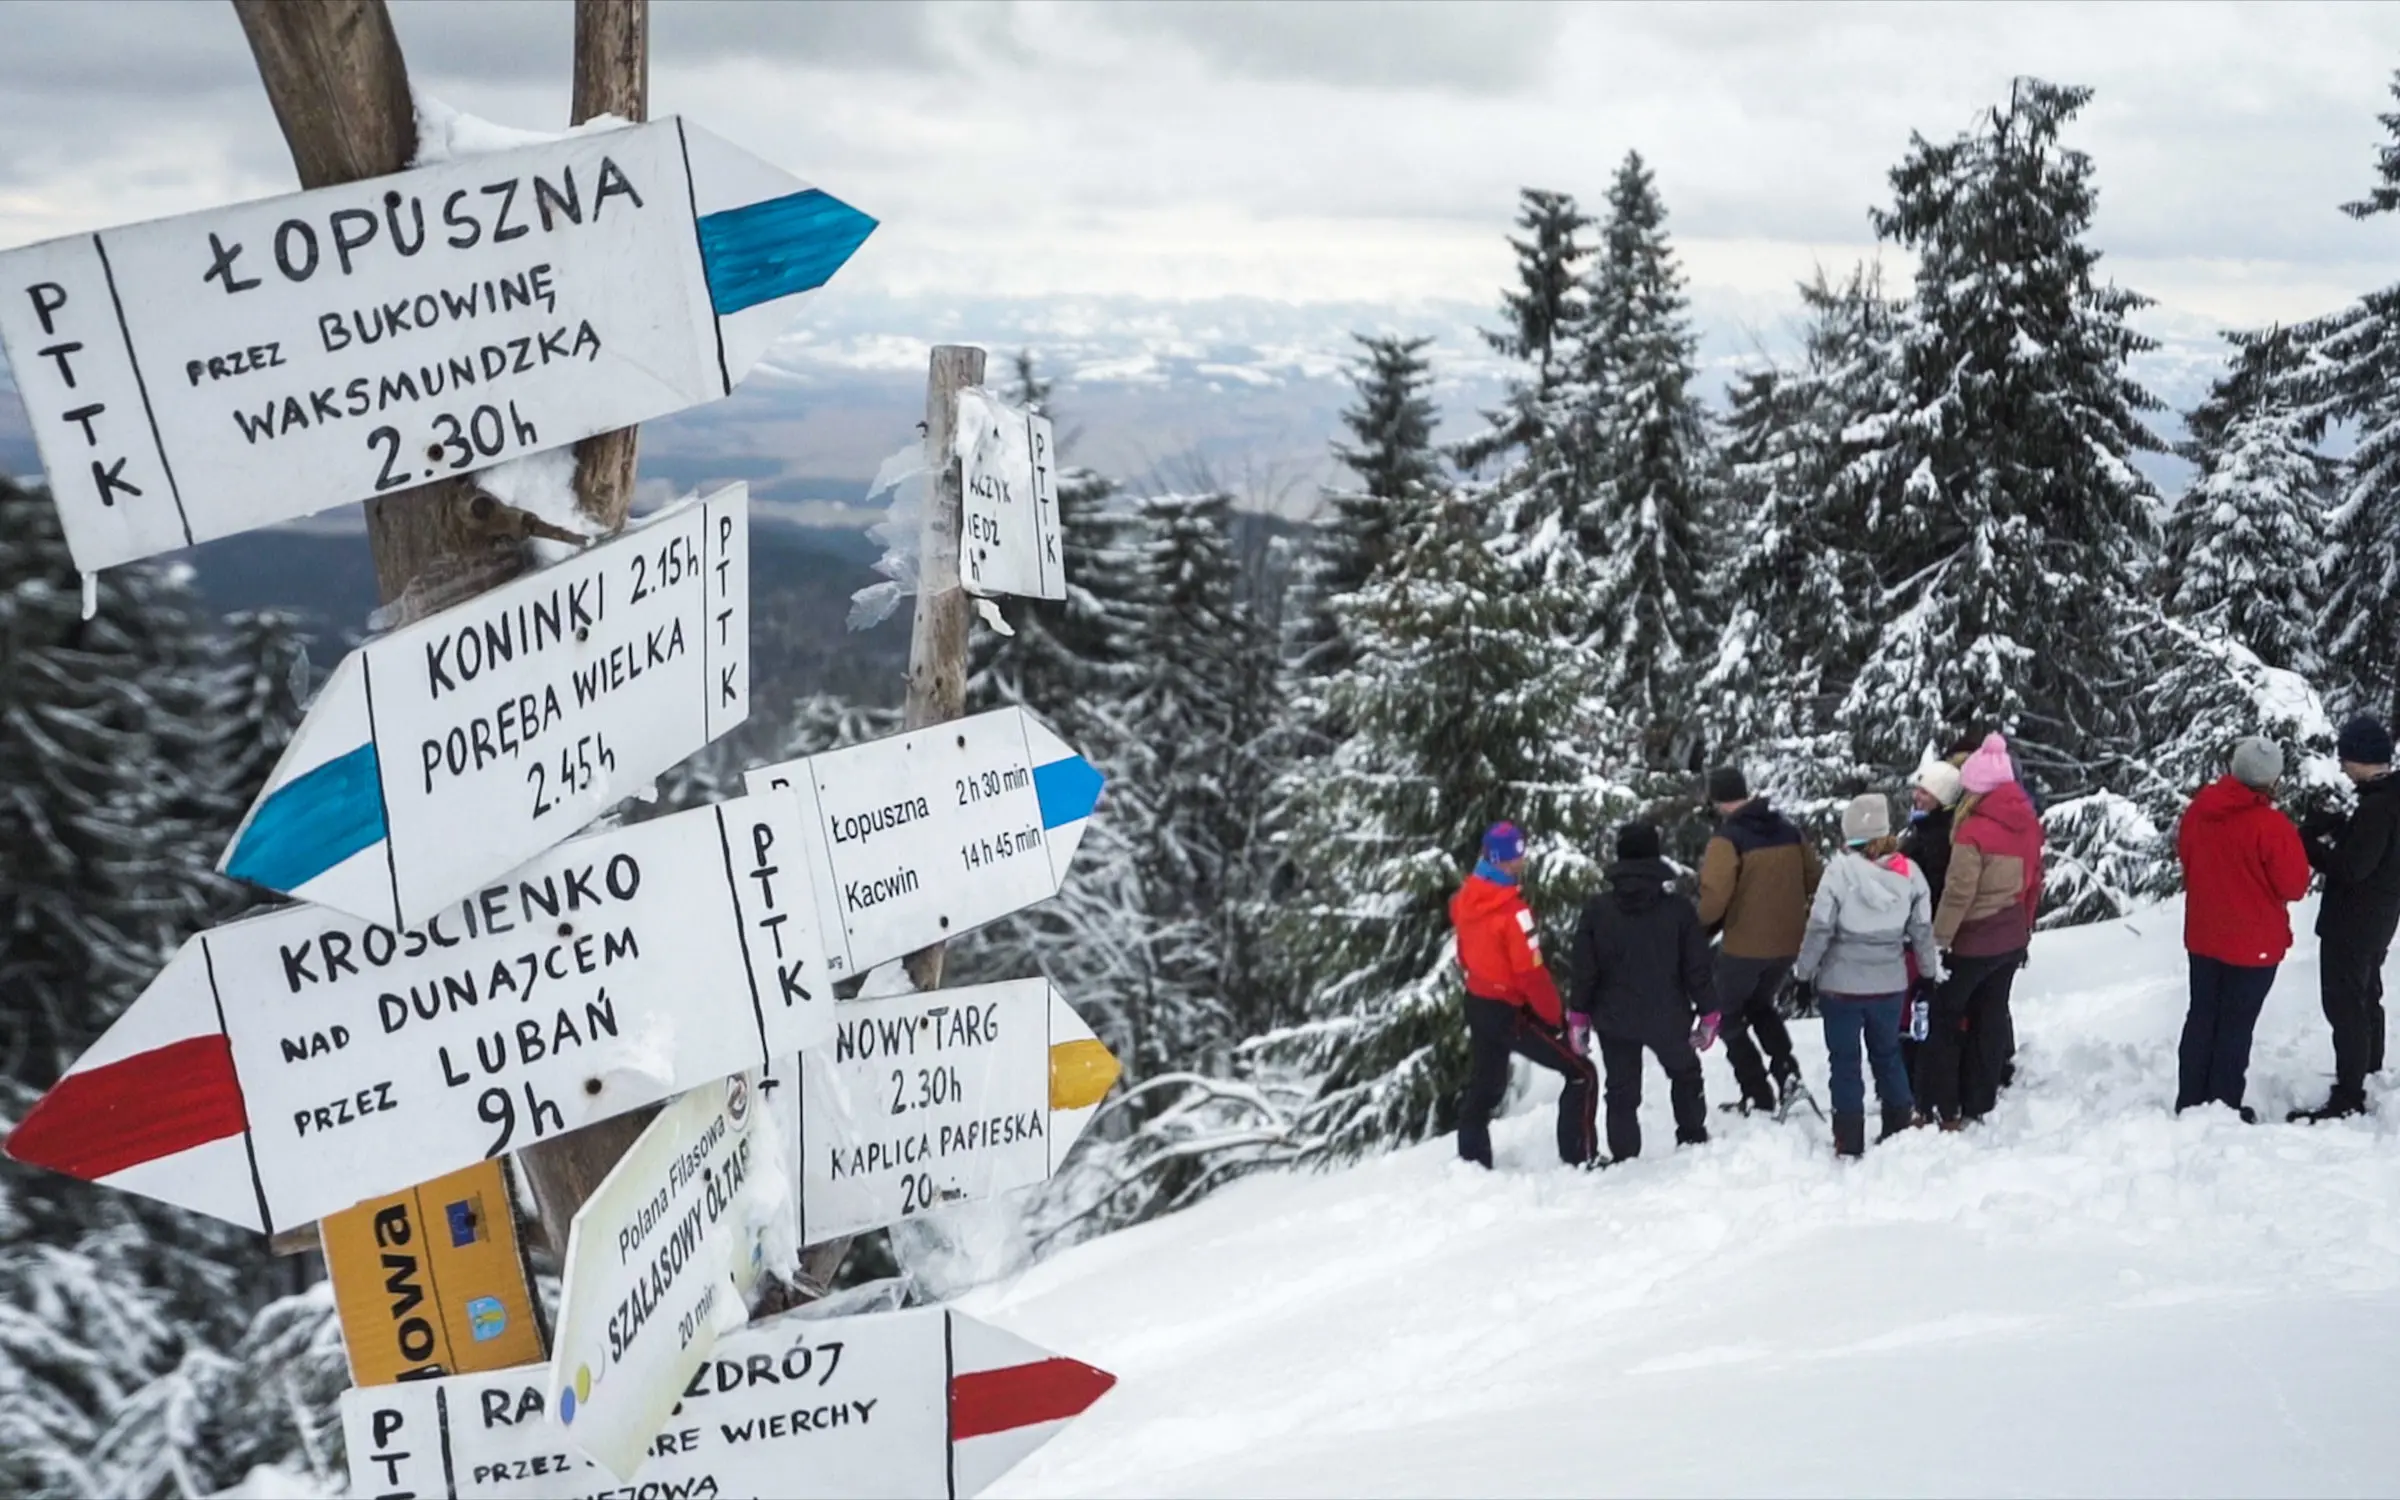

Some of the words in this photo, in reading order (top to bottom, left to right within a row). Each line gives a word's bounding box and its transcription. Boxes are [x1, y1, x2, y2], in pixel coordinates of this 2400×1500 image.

[202, 155, 644, 294] ŁOPUSZNA
[186, 341, 287, 386] PRZEZ
[320, 263, 557, 352] BUKOWINĘ
[232, 319, 602, 444] WAKSMUNDZKĄ
[26, 282, 142, 507] PTTK
[367, 401, 538, 491] 2.30h
[427, 571, 605, 699] KONINKI
[630, 536, 699, 604] 2.15h
[716, 515, 738, 708] PTTK
[422, 683, 562, 795] PORĘBA
[573, 616, 685, 709] WIELKA
[527, 732, 615, 821] 2.45h
[831, 796, 930, 844] Łopuszna
[955, 779, 967, 806] 2
[968, 775, 980, 802] h
[981, 769, 1000, 798] 30
[1003, 762, 1030, 792] min
[750, 822, 812, 1007] PTTK
[845, 865, 919, 913] Kacwin
[961, 842, 980, 872] 14
[982, 838, 993, 865] h
[996, 831, 1013, 859] 45
[1015, 823, 1042, 853] min
[280, 1025, 350, 1063] NAD
[378, 926, 640, 1034] DUNAJCEM
[836, 1015, 918, 1063] NOWY
[927, 1002, 999, 1051] TARG
[294, 1081, 398, 1137] PRZEZ
[438, 985, 619, 1087] LUBAŃ
[477, 1081, 564, 1158] 9h
[891, 1065, 962, 1115] 2.30h
[618, 1187, 669, 1265] Polana
[669, 1114, 726, 1200] Filasowa
[831, 1133, 931, 1180] KAPLICA
[940, 1109, 1043, 1157] PAPIESKA
[901, 1172, 932, 1215] 20
[608, 1198, 704, 1363] SZAŁASOWY
[678, 1309, 694, 1351] 20
[473, 1453, 572, 1484] PRZEZ
[720, 1398, 878, 1444] WIERCHY
